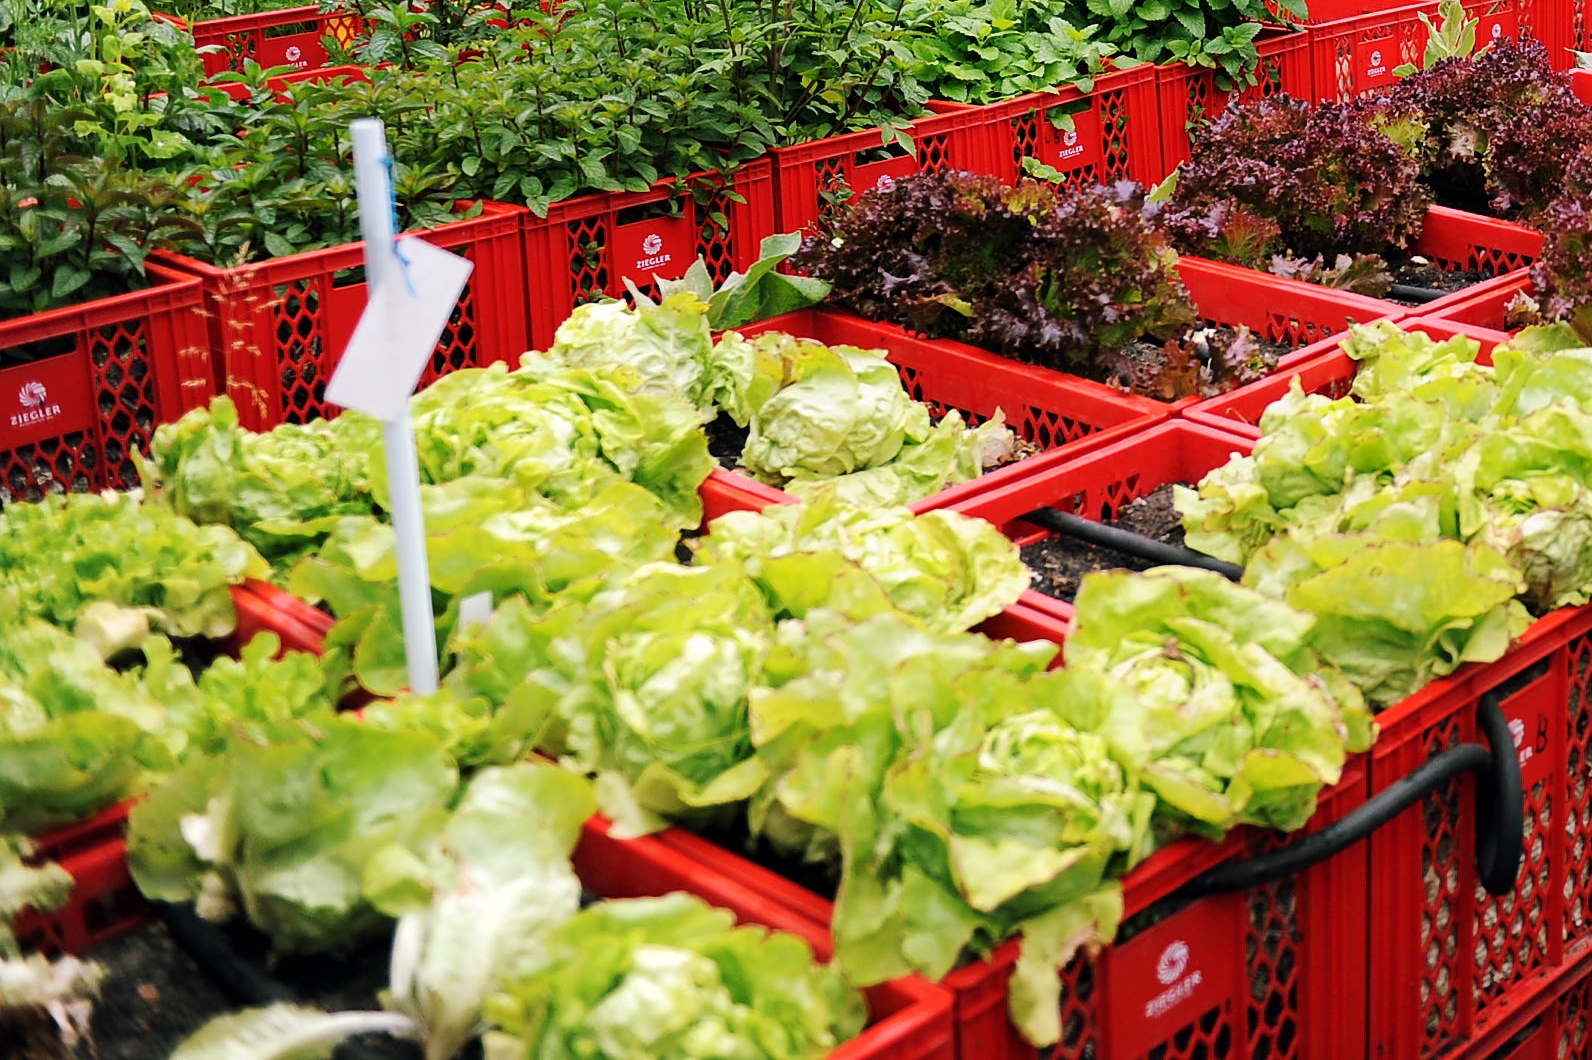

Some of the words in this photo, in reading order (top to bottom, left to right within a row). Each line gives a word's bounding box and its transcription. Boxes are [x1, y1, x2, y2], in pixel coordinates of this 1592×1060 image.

[1059, 145, 1084, 157] ZIEGLER
[636, 254, 671, 268] ZIEGLER
[11, 404, 61, 426] ZIEGLER
[1145, 970, 1203, 1018] ZIEGLER
